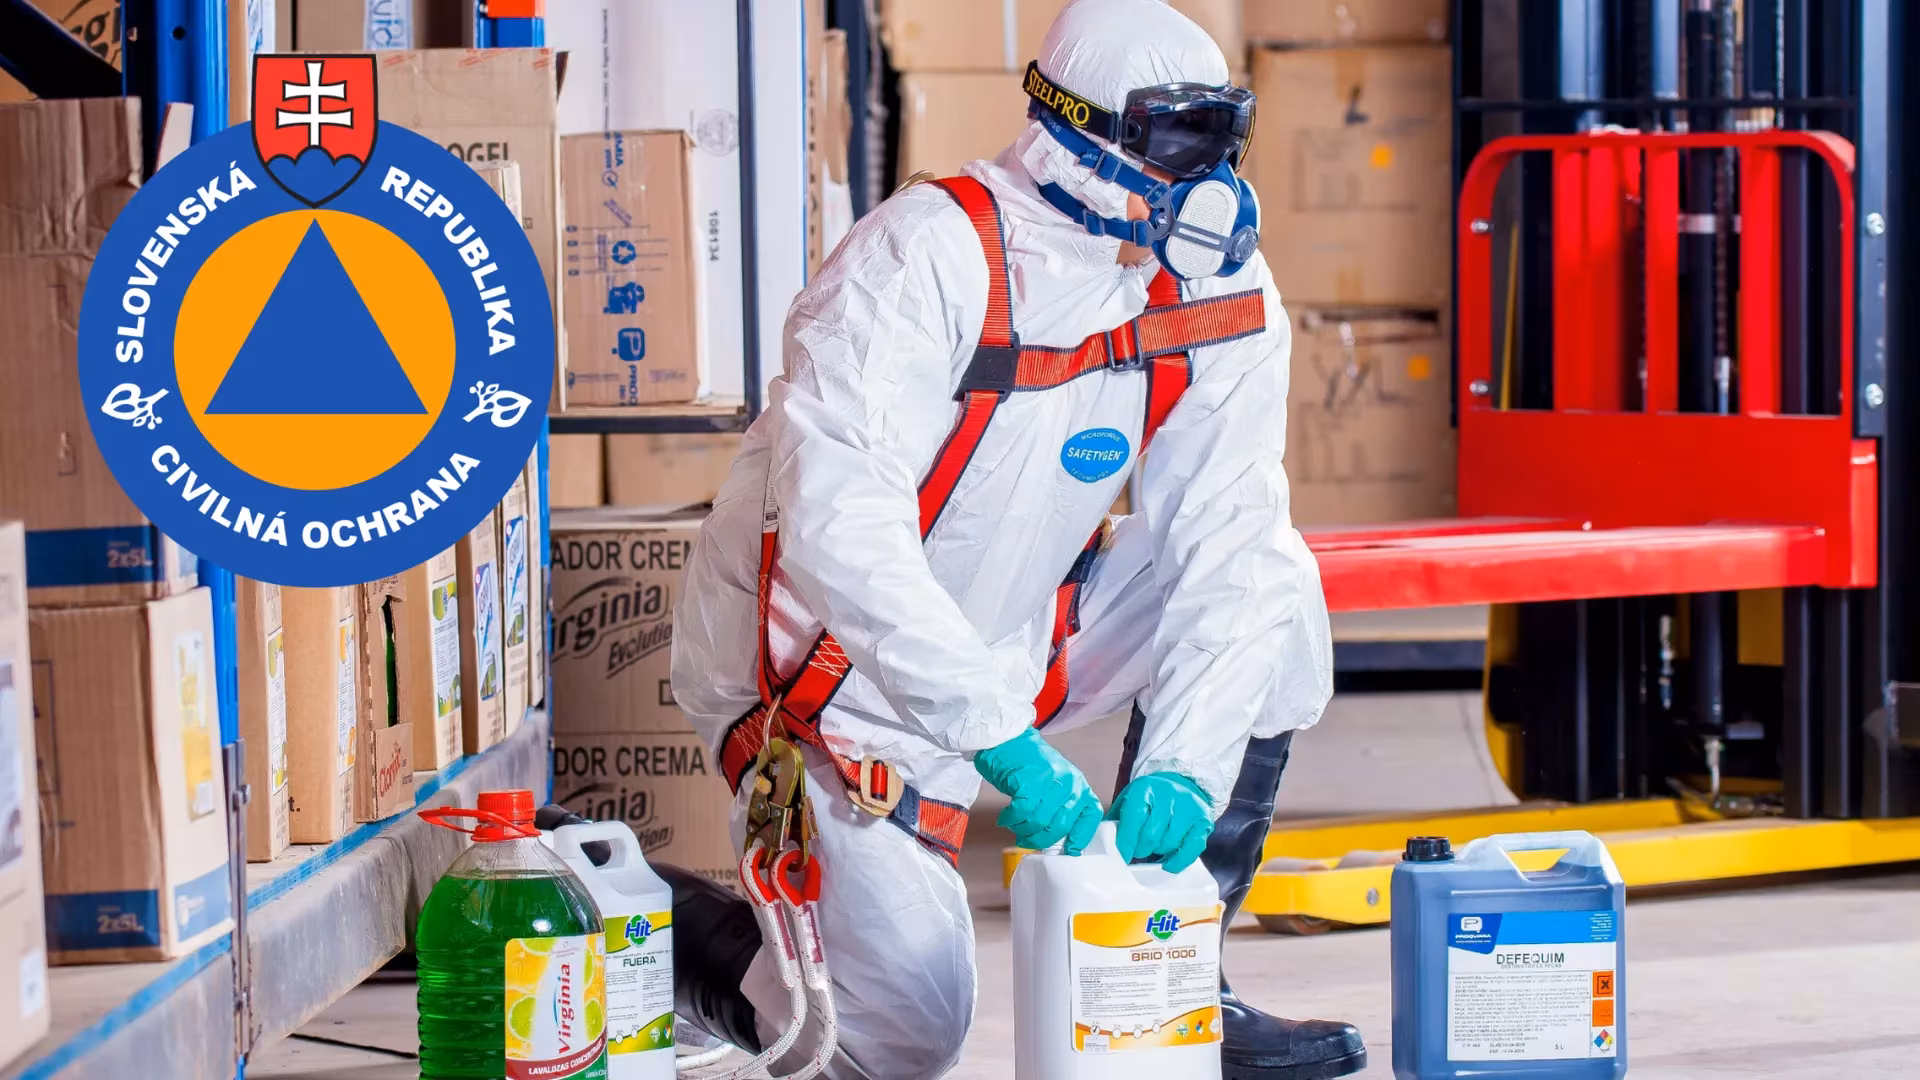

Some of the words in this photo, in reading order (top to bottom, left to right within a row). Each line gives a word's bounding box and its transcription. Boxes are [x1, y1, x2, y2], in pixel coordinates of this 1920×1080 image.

[1026, 69, 1091, 128] STEELPRO
[1067, 447, 1122, 461] SAFETYGEN
[615, 746, 707, 776] CREMA
[625, 919, 652, 939] Hit
[1146, 913, 1181, 933] Hit
[623, 956, 657, 967] FUERA
[1131, 952, 1163, 962] BRIO
[1166, 949, 1196, 960] 1000
[1496, 953, 1564, 964] DEFEQUIM
[558, 962, 575, 1054] Virginia
[528, 1062, 570, 1075] LAVALOZAS
